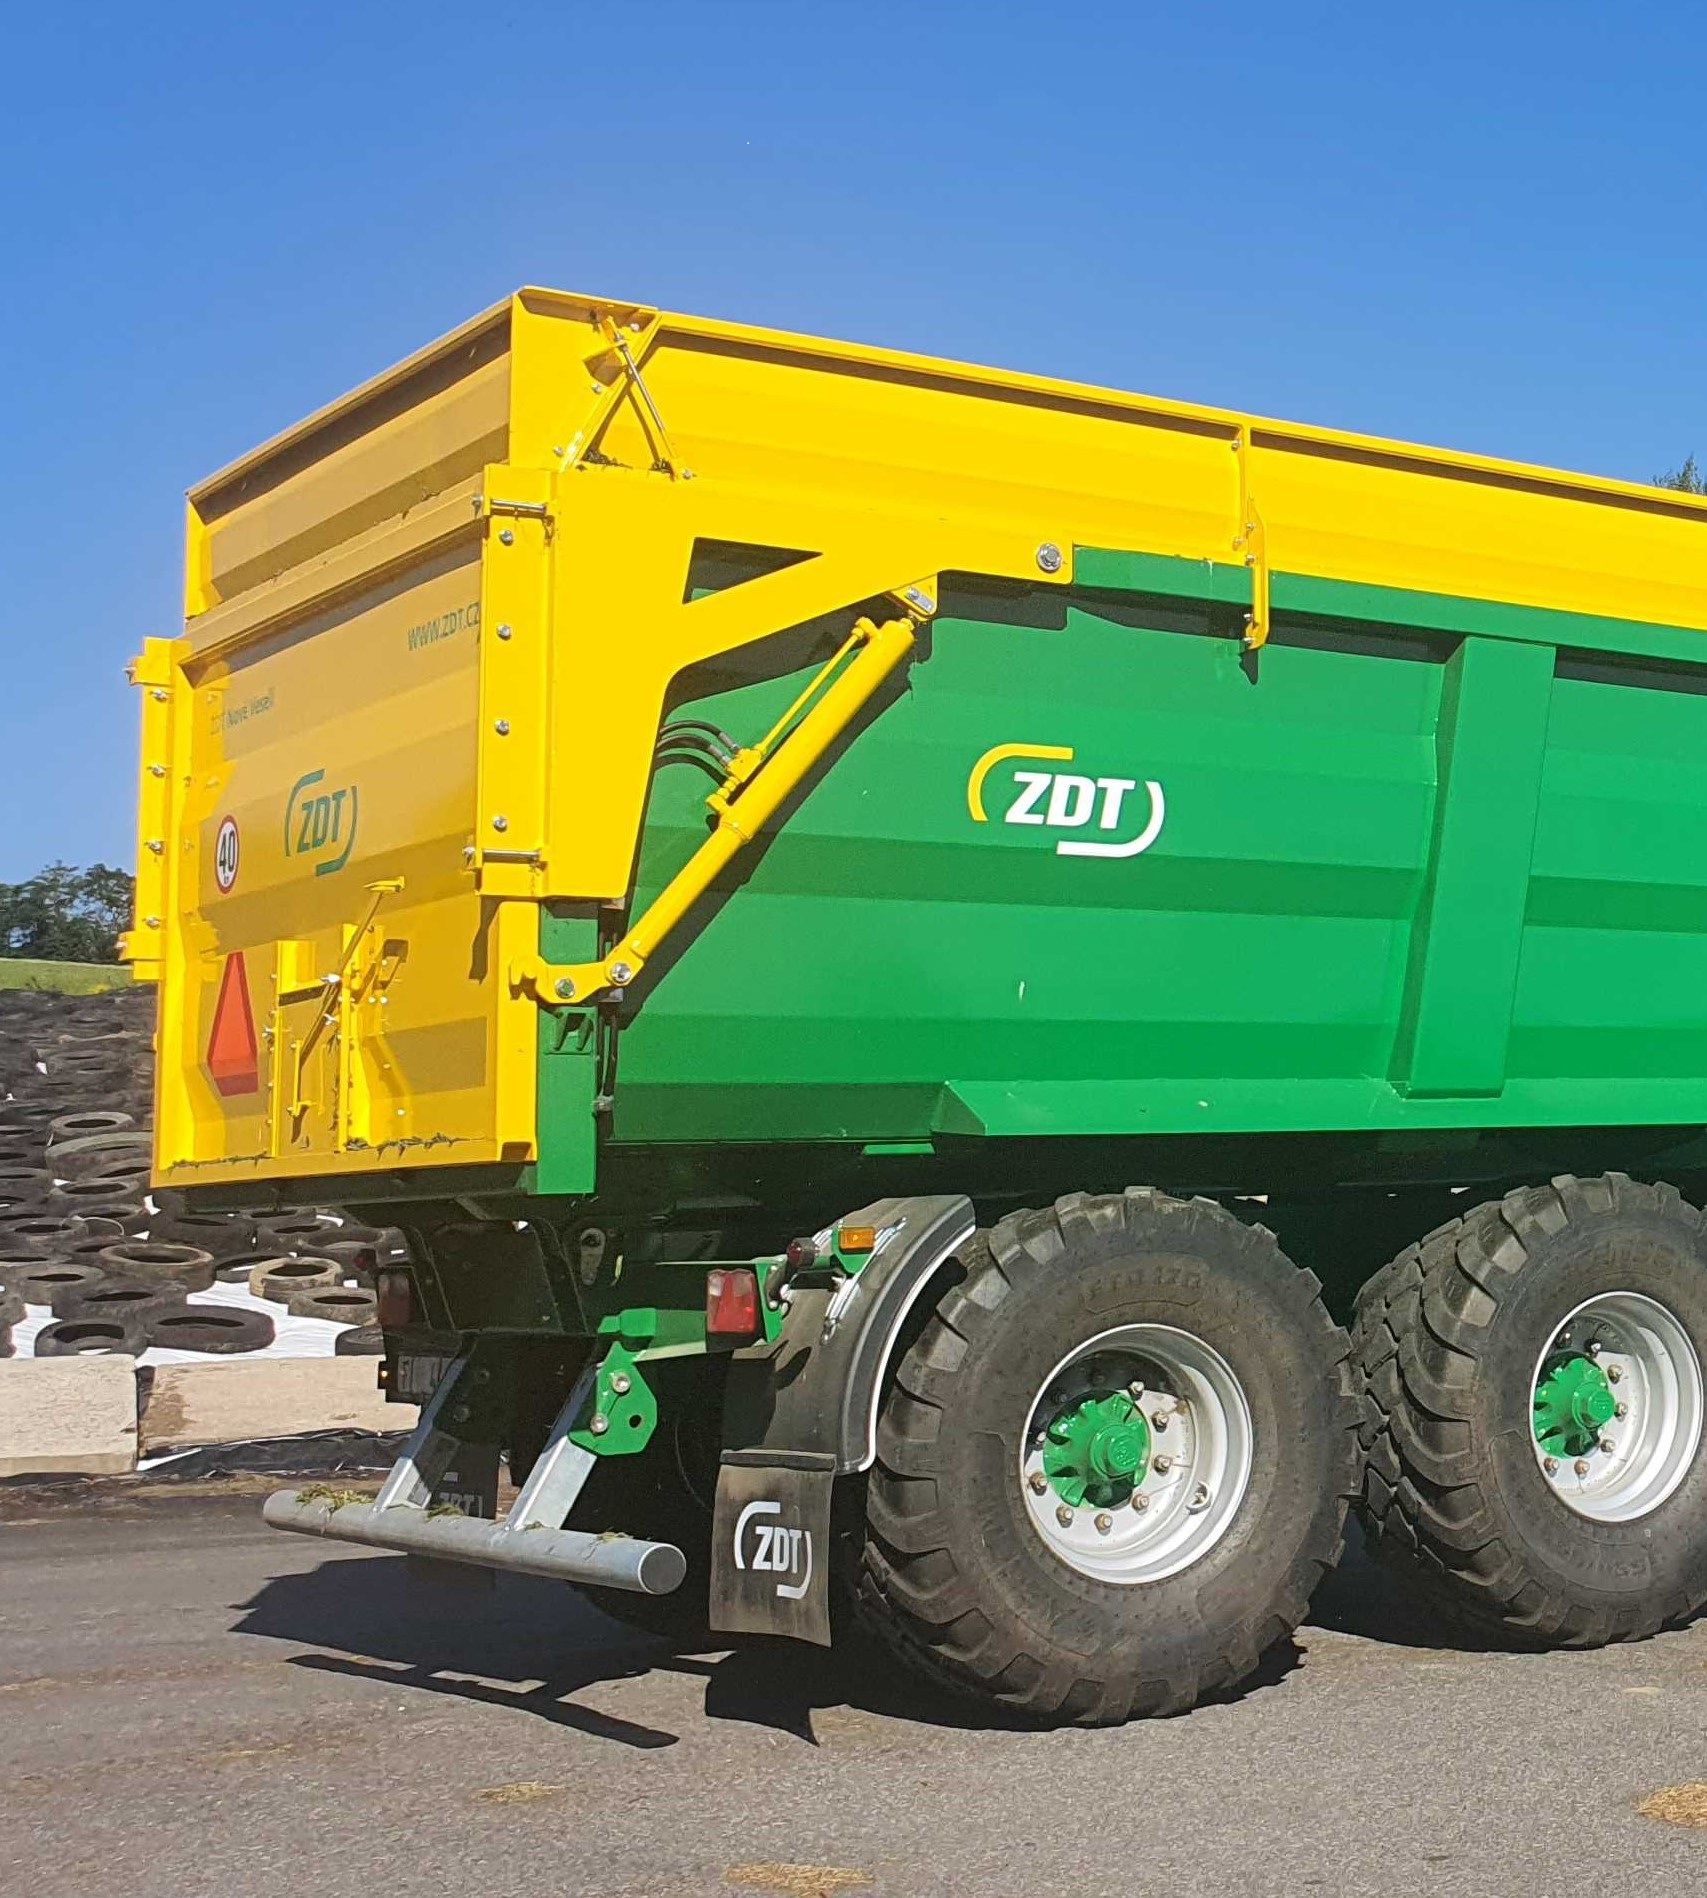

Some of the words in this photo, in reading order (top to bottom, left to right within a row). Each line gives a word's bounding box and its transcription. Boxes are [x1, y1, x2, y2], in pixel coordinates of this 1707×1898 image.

[297, 789, 348, 853] ZDT
[1004, 771, 1137, 831] ZDT
[219, 829, 237, 876] 40
[752, 1525, 802, 1574] ZDT
